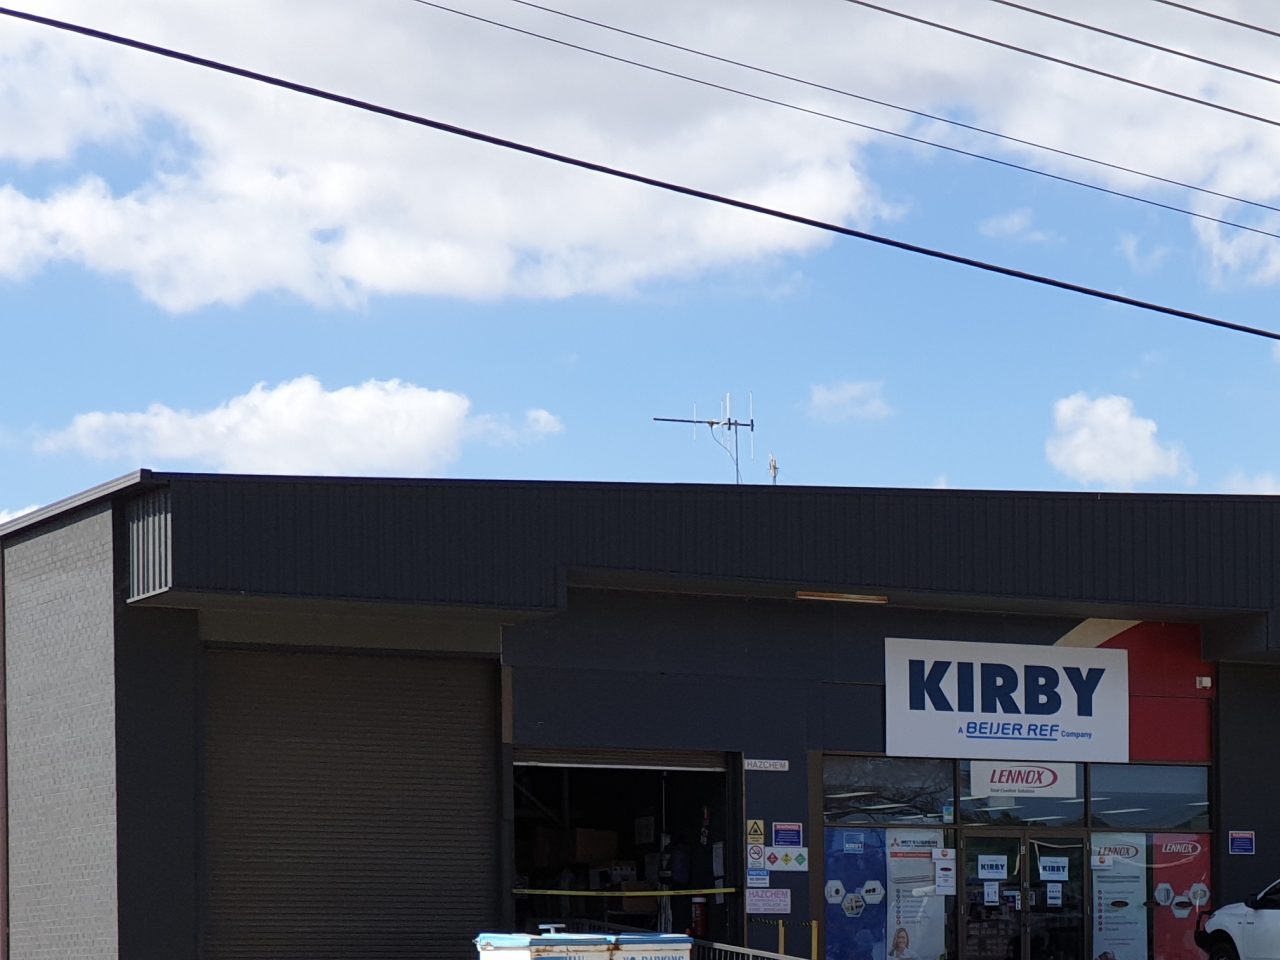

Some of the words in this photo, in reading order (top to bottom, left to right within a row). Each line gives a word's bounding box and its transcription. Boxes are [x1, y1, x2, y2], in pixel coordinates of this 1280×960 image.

[908, 659, 1106, 717] KIRBY
[958, 726, 964, 734] A
[966, 721, 1023, 736] BEIJER
[1027, 723, 1060, 737] REF
[1061, 730, 1093, 740] Company
[746, 760, 787, 769] HAZCHEM
[989, 769, 1045, 785] LENNOX
[1098, 847, 1131, 856] LENNOX
[1162, 843, 1194, 853] LENNOX
[748, 890, 788, 899] HAZCHEM
